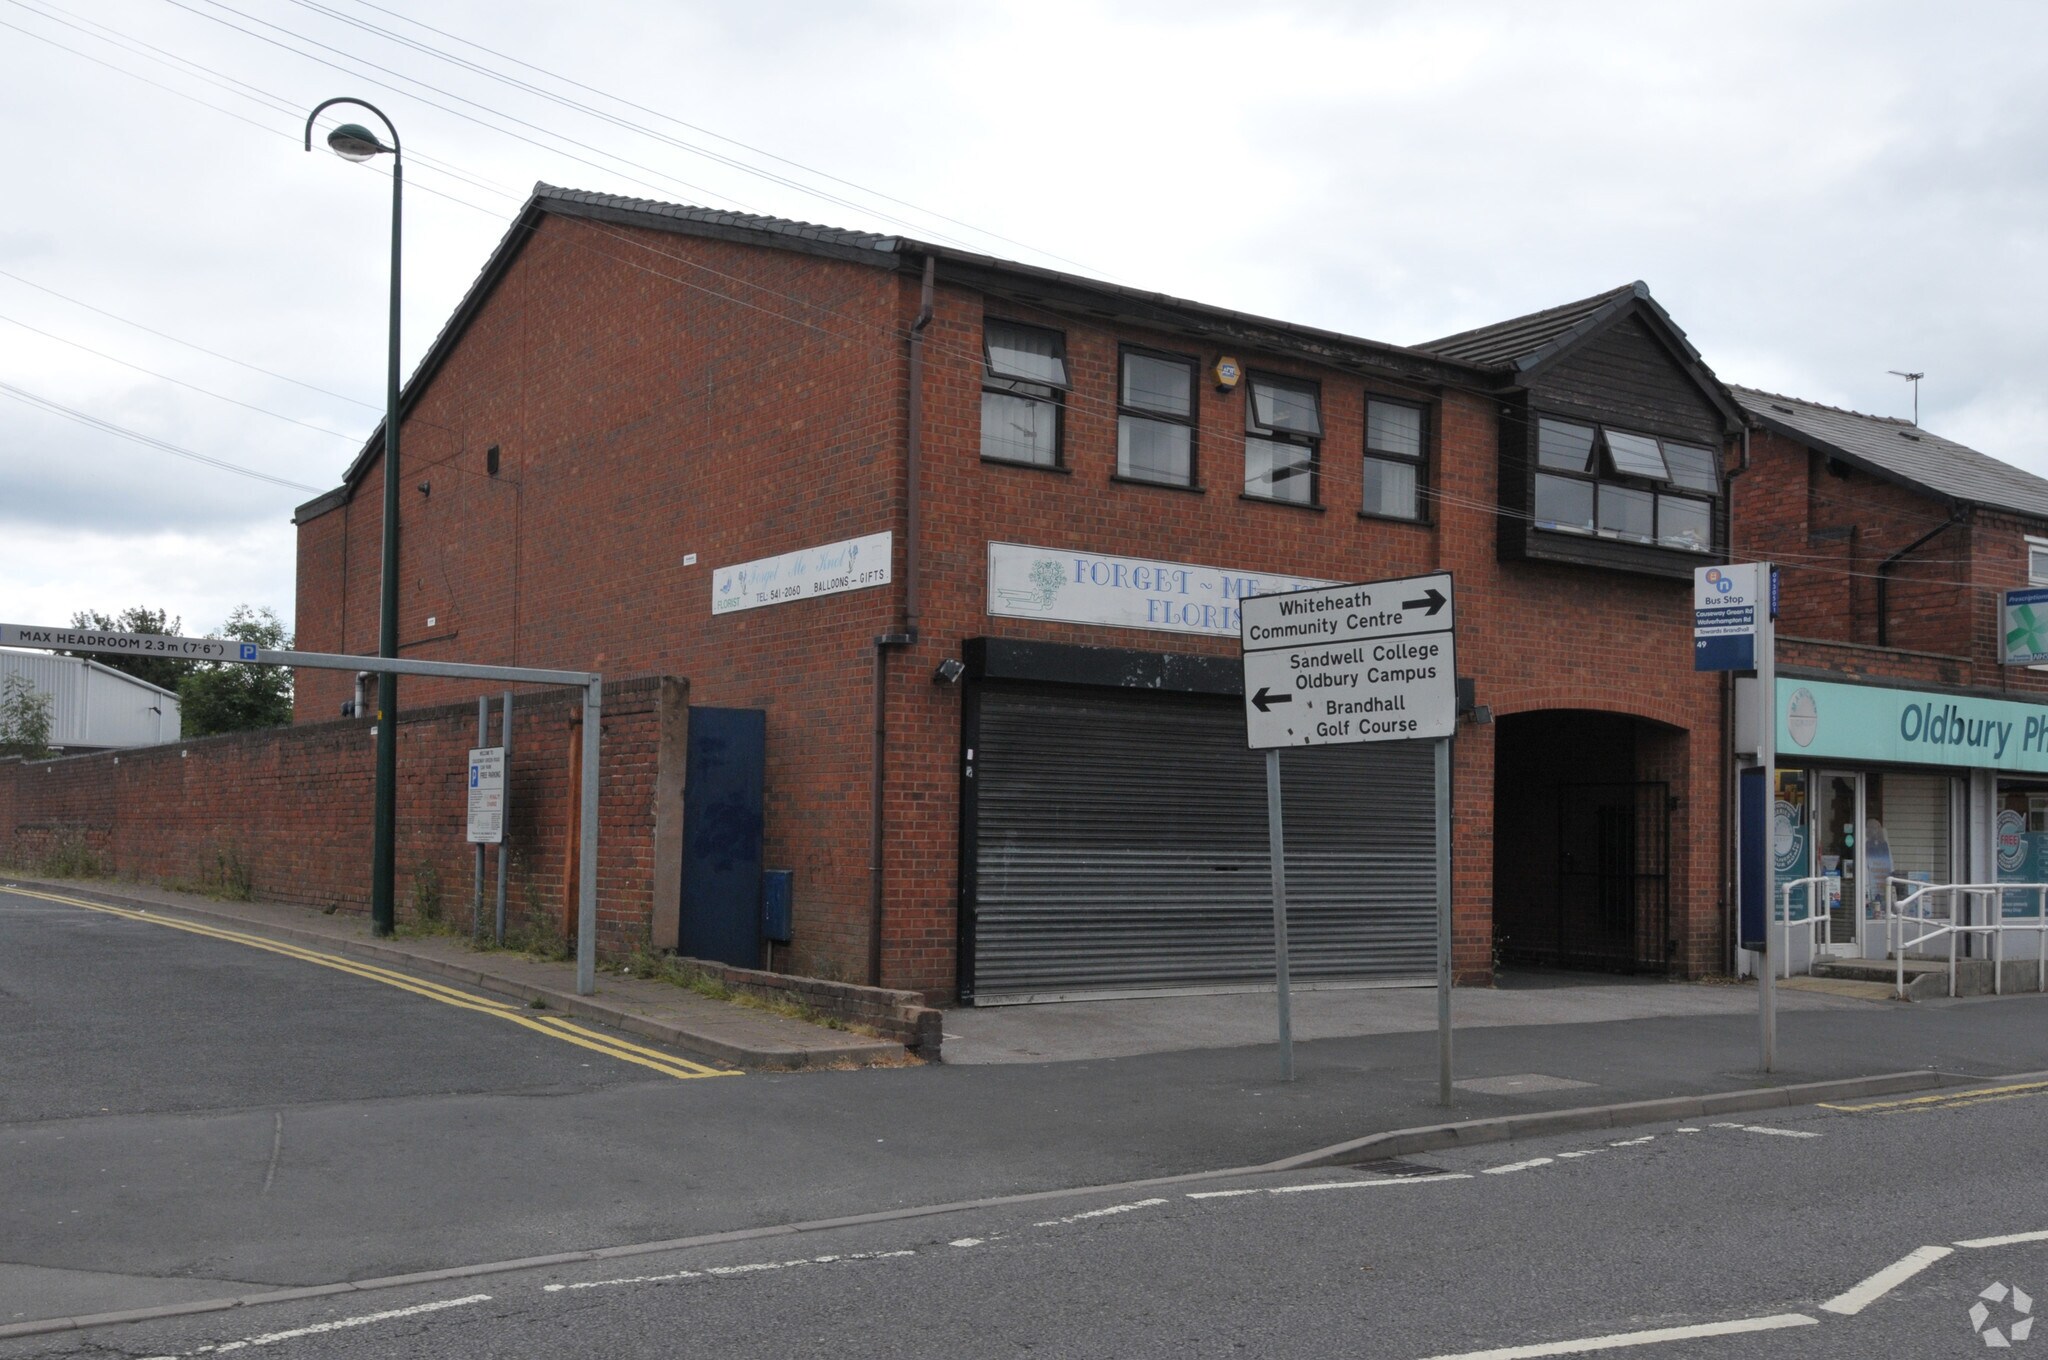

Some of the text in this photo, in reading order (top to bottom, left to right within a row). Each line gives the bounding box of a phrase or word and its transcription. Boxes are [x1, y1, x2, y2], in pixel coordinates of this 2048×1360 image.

[813, 576, 849, 593] BALLOONS
[859, 569, 884, 583] GIFTS
[1073, 559, 1194, 595] FORGET
[1221, 575, 1260, 600] ME
[717, 596, 741, 610] FLORIST
[756, 585, 801, 604] TEL: 541-2060
[1279, 592, 1372, 616] Whiteheath
[1705, 595, 1744, 605] Bus Stop
[1695, 610, 1725, 618] Causeway
[1697, 618, 1742, 626] Wolverhampton
[1250, 611, 1403, 641] Community Centre
[20, 630, 51, 643] MAX
[57, 633, 140, 649] HEADROOM
[1290, 643, 1439, 669] Sandwell College
[1295, 667, 1437, 690] Oldbury Campus
[1326, 695, 1406, 715] Brandhall
[1316, 719, 1418, 738] Golf Course
[1900, 702, 2013, 760] Oldbury
[2001, 834, 2018, 846] FREE
